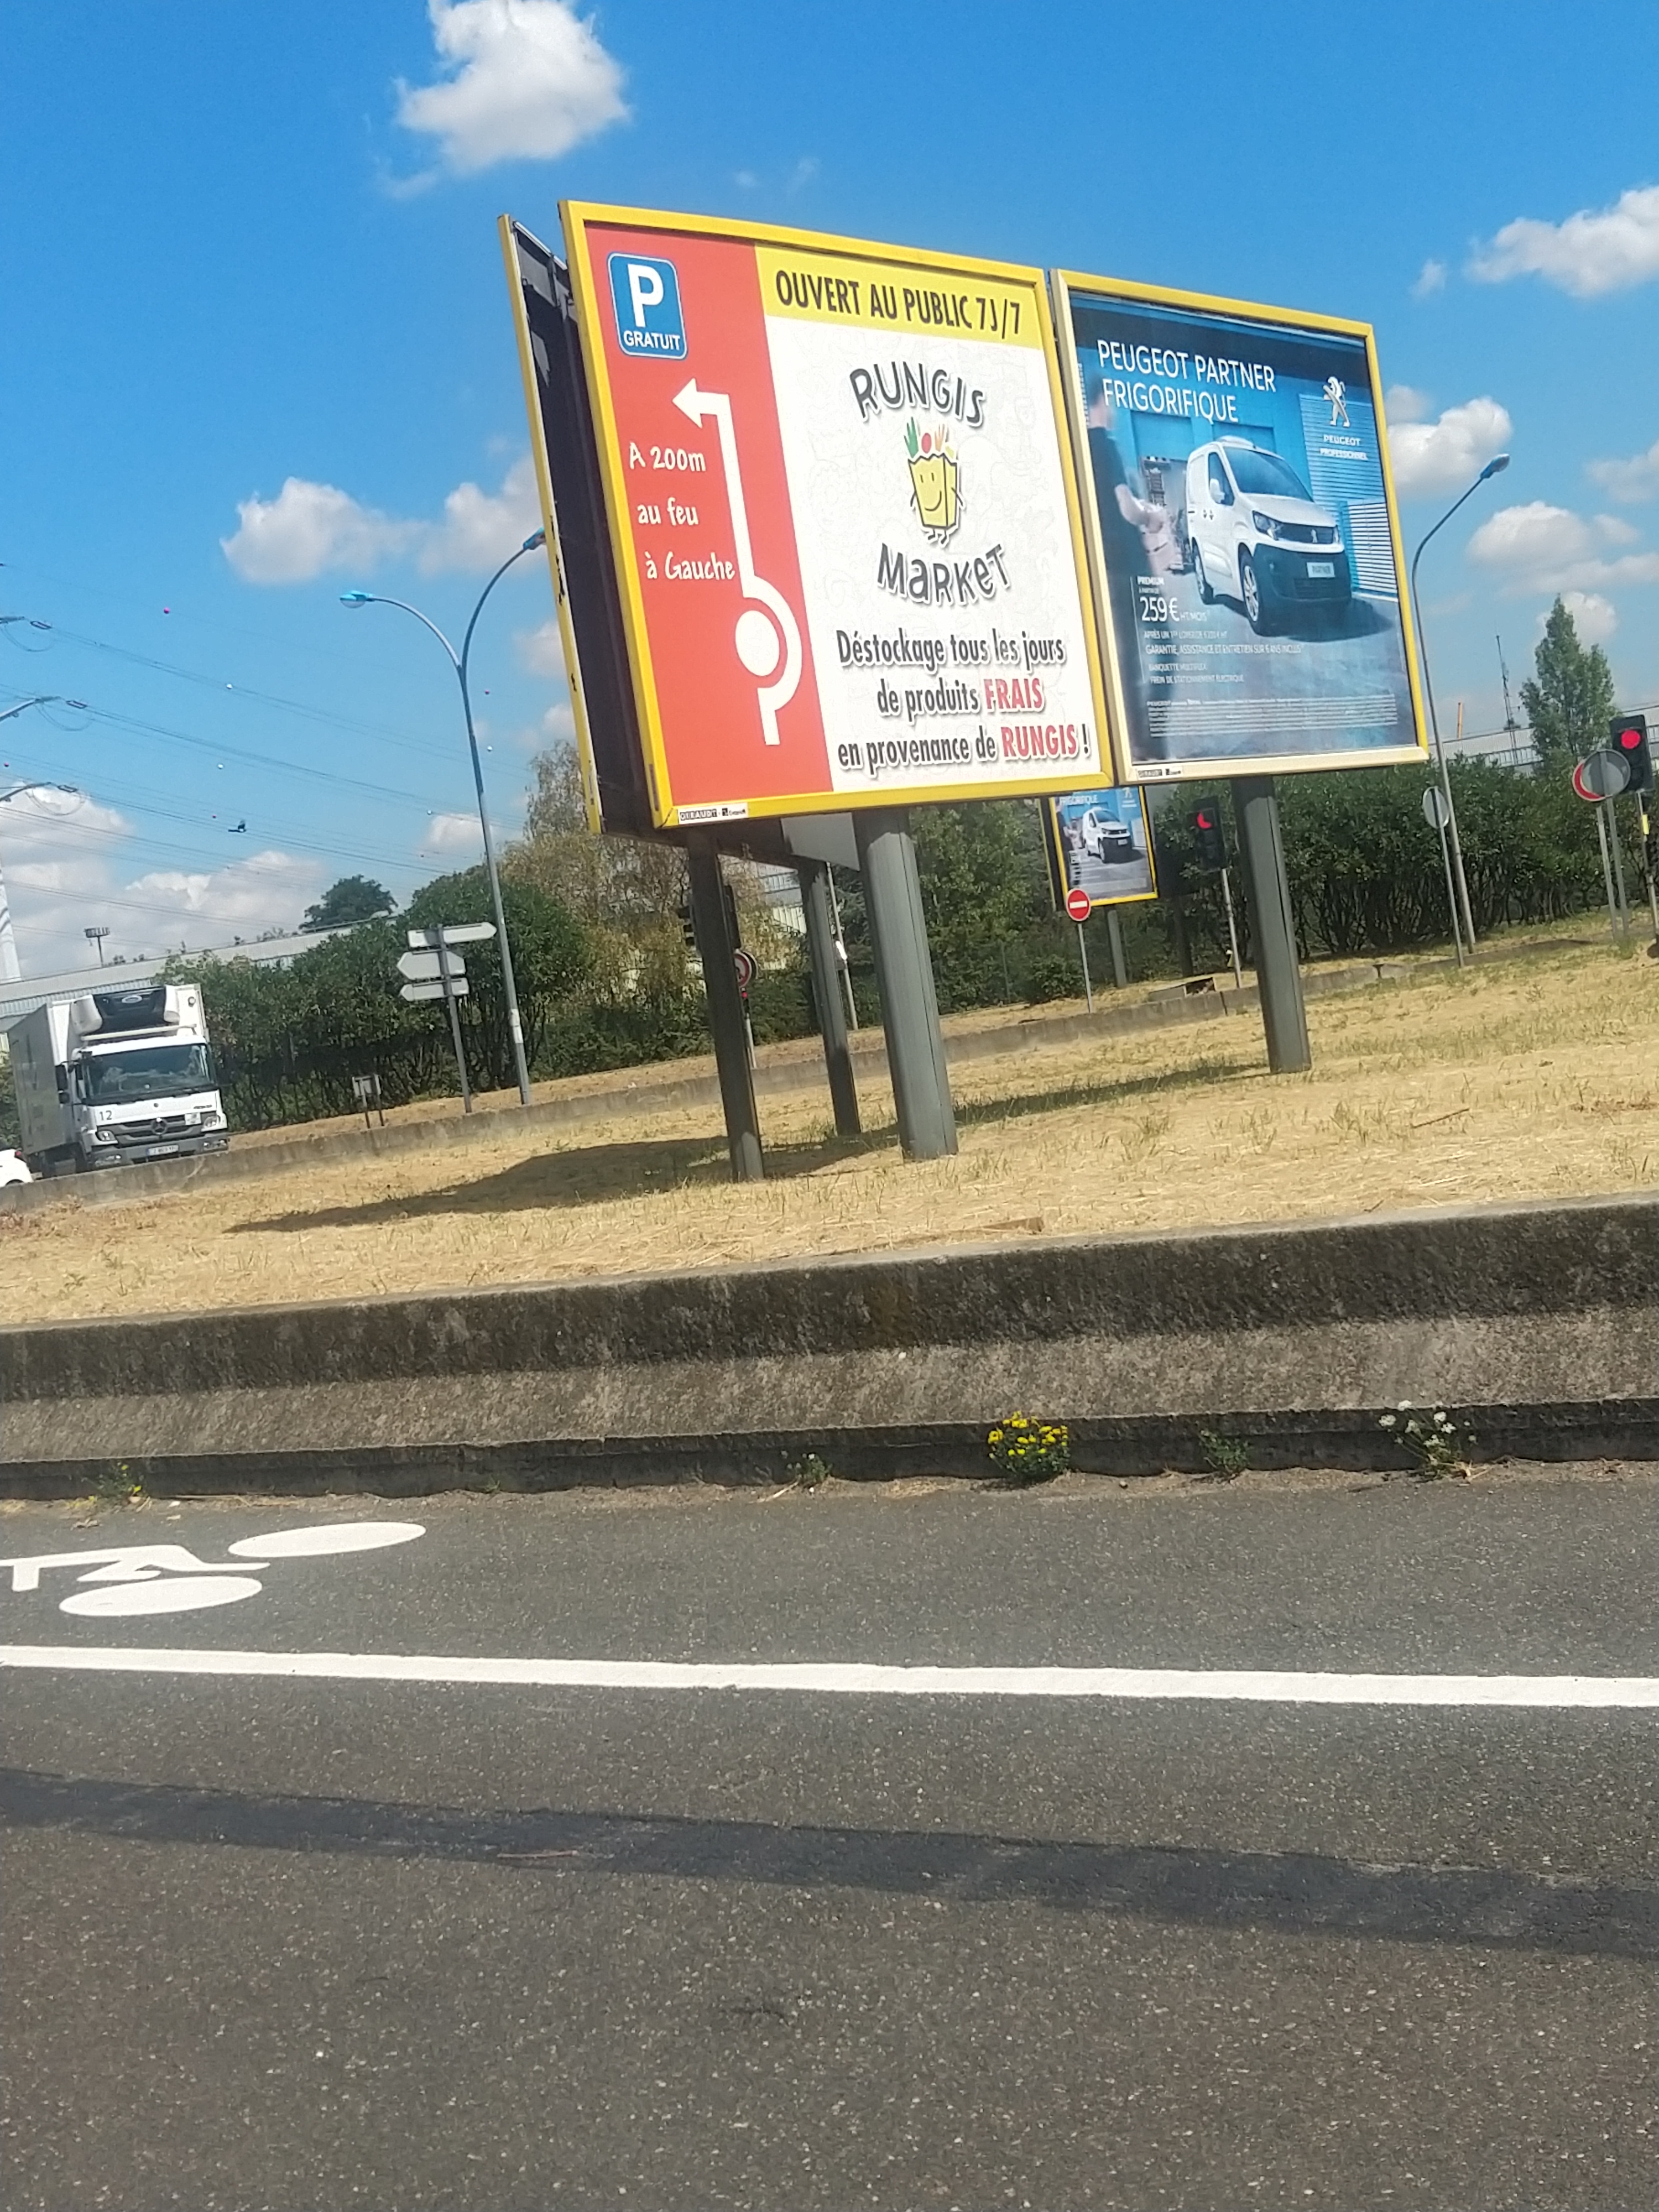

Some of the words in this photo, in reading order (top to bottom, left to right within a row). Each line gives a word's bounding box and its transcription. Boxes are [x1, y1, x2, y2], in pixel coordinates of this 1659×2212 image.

[627, 264, 664, 327] P
[776, 270, 860, 315] OUVERT
[870, 284, 898, 319] AU
[903, 288, 972, 329] PUBLIC
[976, 298, 1020, 339] 7J/7
[624, 331, 680, 351] GRATUIT
[1098, 340, 1190, 380] PEUGEOT
[1194, 354, 1276, 392] PARTNER
[849, 362, 984, 424] RUNGIS
[1102, 379, 1239, 425] FRIGORIFIQUE
[629, 442, 645, 470] A
[650, 446, 706, 472] 200m
[1323, 434, 1360, 446] PEUGEOT
[638, 504, 661, 526] au
[667, 497, 698, 526] feu
[646, 551, 658, 580] à
[665, 551, 735, 581] Gauche
[1140, 597, 1167, 622] 259
[836, 627, 945, 671] Déstockage
[951, 634, 988, 662] tous
[992, 628, 1018, 662] les
[1021, 631, 1065, 671] jours
[877, 679, 899, 713] de
[906, 677, 979, 722] produits
[983, 677, 1043, 710] FRAIS
[838, 741, 861, 766] en
[866, 738, 969, 775] provenance
[975, 725, 996, 759] de
[1000, 724, 1077, 757] RUNGIS
[100, 1110, 112, 1120] 12
